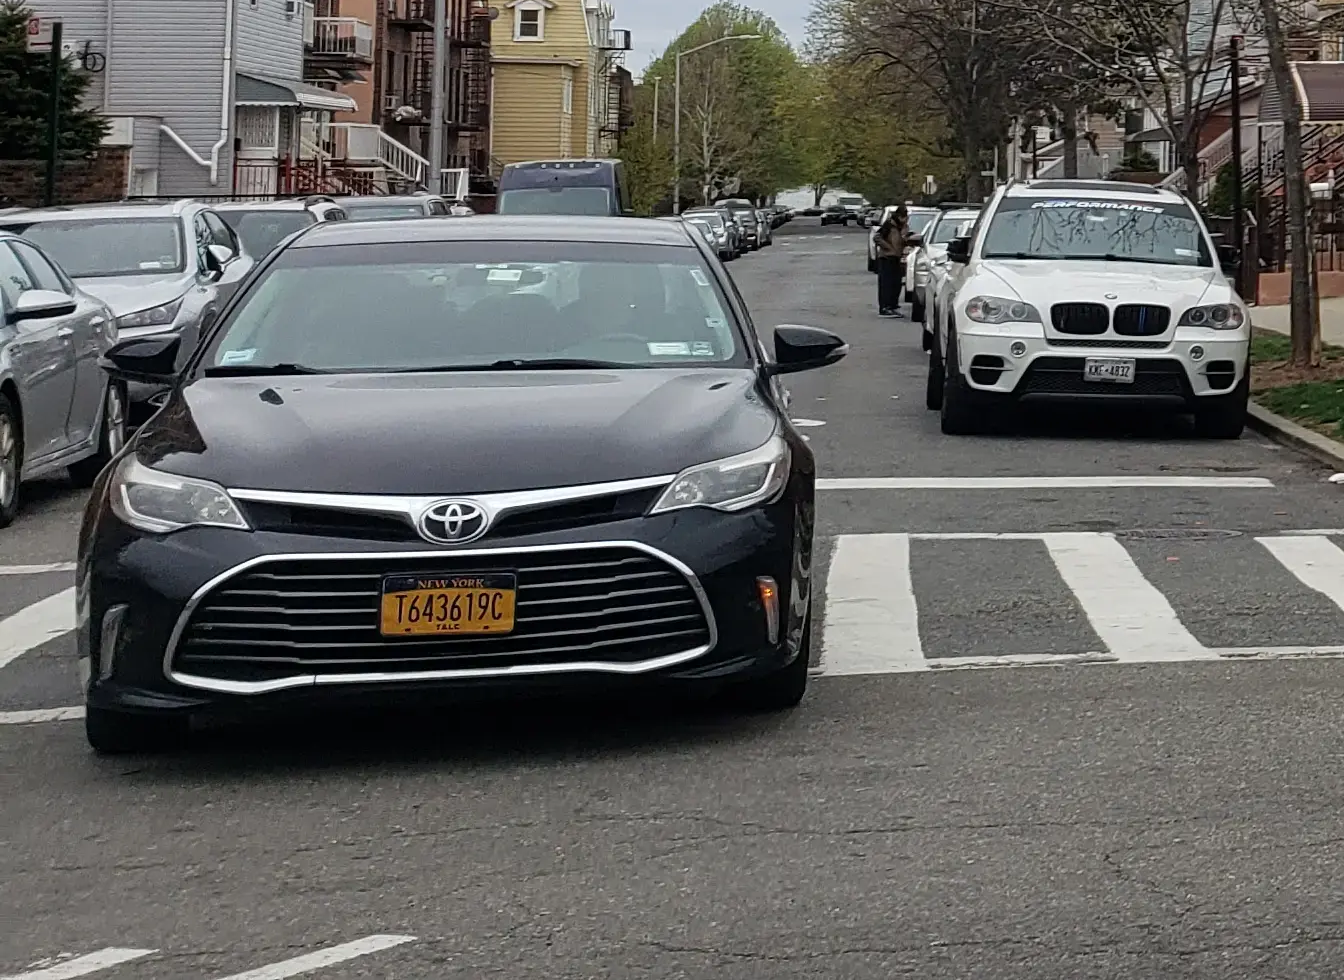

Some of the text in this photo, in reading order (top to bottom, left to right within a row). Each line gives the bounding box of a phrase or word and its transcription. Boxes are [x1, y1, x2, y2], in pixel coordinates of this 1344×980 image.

[1031, 201, 1165, 214] PERFORMANCE
[417, 578, 485, 589] NEW YORK
[395, 591, 503, 624] T643619C
